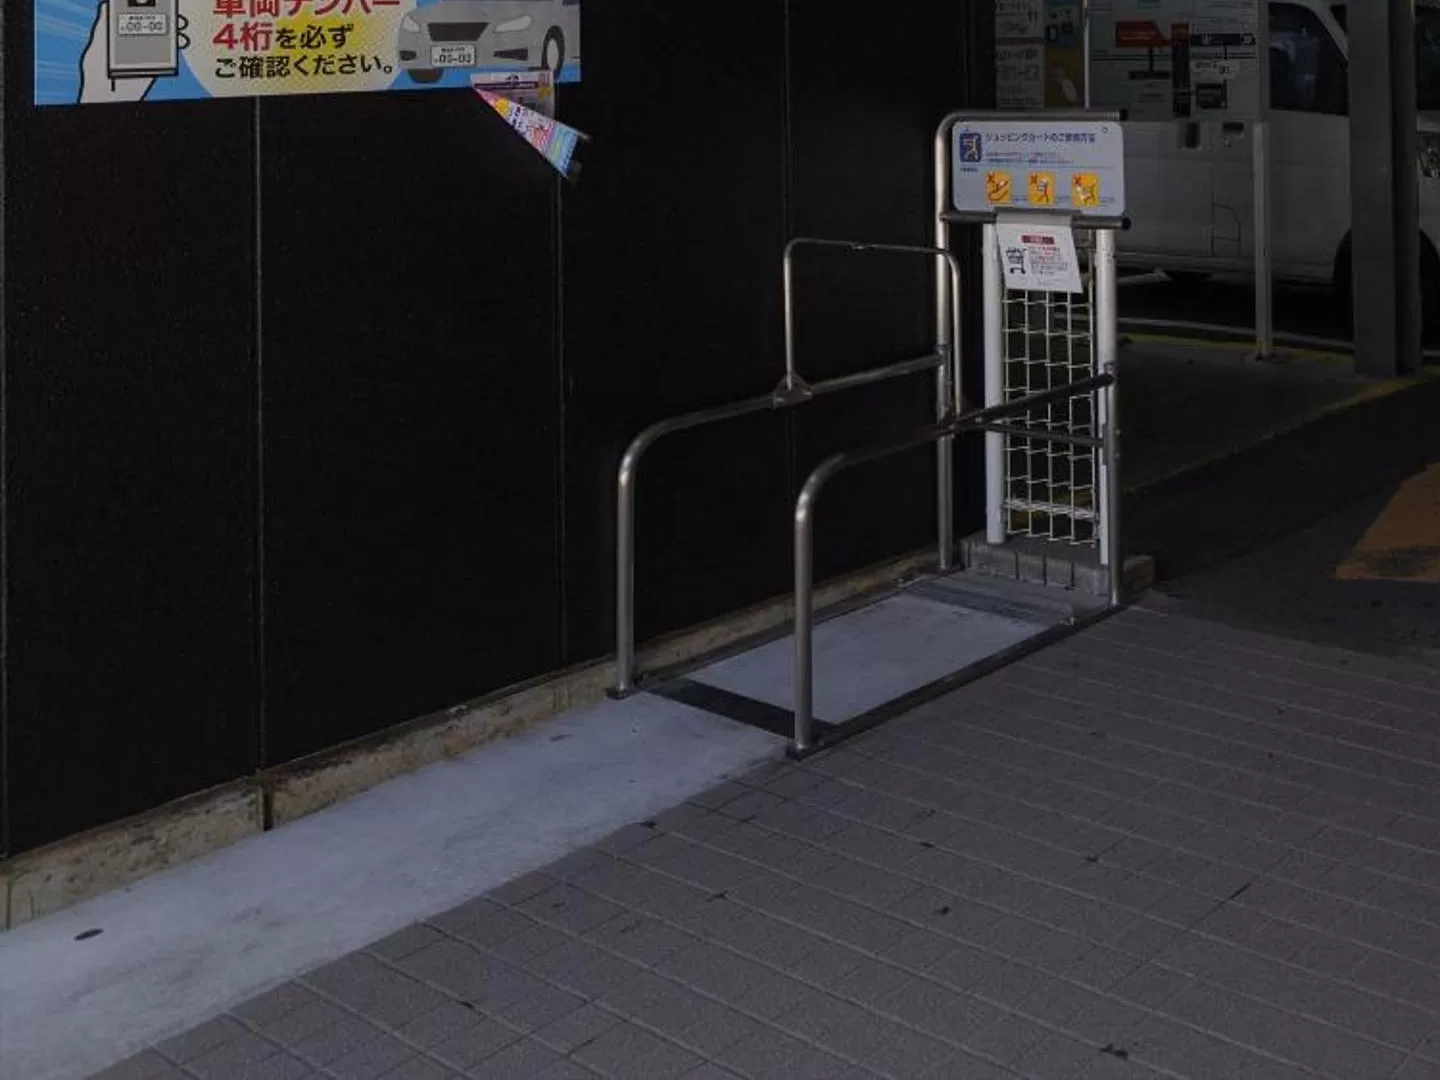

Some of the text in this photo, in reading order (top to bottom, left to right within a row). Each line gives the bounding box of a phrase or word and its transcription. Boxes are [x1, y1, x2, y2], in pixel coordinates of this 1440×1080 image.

[212, 22, 354, 51] 4桁を必ず
[214, 53, 393, 80] ご確認ください。
